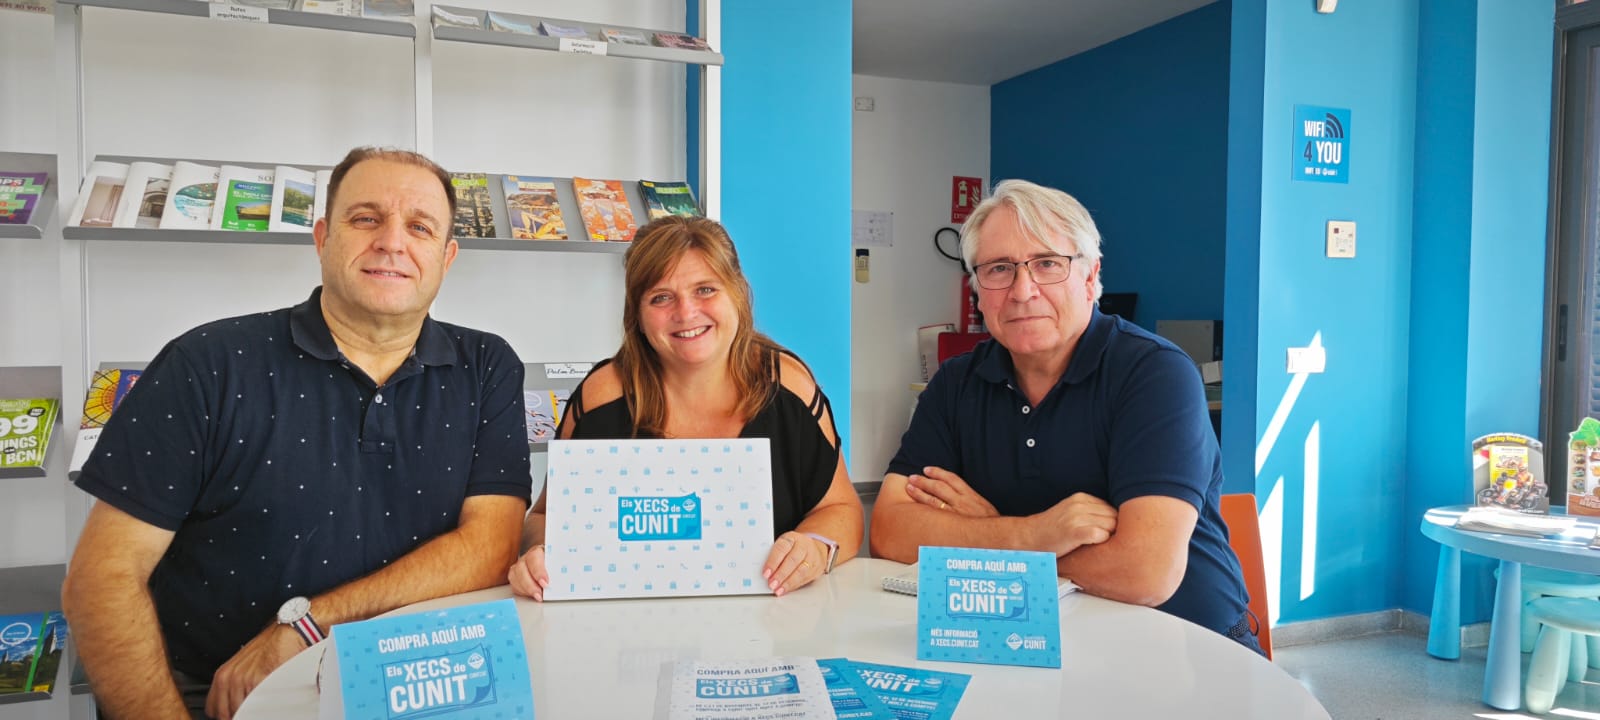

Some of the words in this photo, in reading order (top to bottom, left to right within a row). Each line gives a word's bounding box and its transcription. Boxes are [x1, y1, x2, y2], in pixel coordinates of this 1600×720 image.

[1304, 120, 1326, 137] WIFI
[1303, 141, 1313, 162] 4
[1316, 141, 1342, 165] YOU
[0, 436, 38, 450] INGS
[6, 449, 37, 465] BCN
[621, 500, 633, 508] Els
[634, 499, 669, 513] XECS
[670, 504, 681, 512] de
[621, 514, 681, 535] CUNIT
[946, 559, 983, 571] COMPRA
[984, 560, 1006, 573] AQUÍ
[1007, 562, 1027, 573] AMB
[949, 579, 961, 587] Els
[961, 579, 996, 593] XECS
[997, 586, 1008, 594] de
[949, 593, 1008, 614] CUNIT
[378, 633, 429, 654] COMPRA
[431, 625, 459, 645] AQUÍ
[461, 624, 486, 640] AMB
[1024, 640, 1047, 650] CUNIT
[386, 665, 402, 678] Els
[403, 657, 451, 682] XECS
[453, 663, 466, 674] de
[860, 670, 908, 681] XECS
[700, 685, 772, 696] CUNIT
[716, 679, 758, 687] XECS
[390, 674, 468, 713] CUNIT
